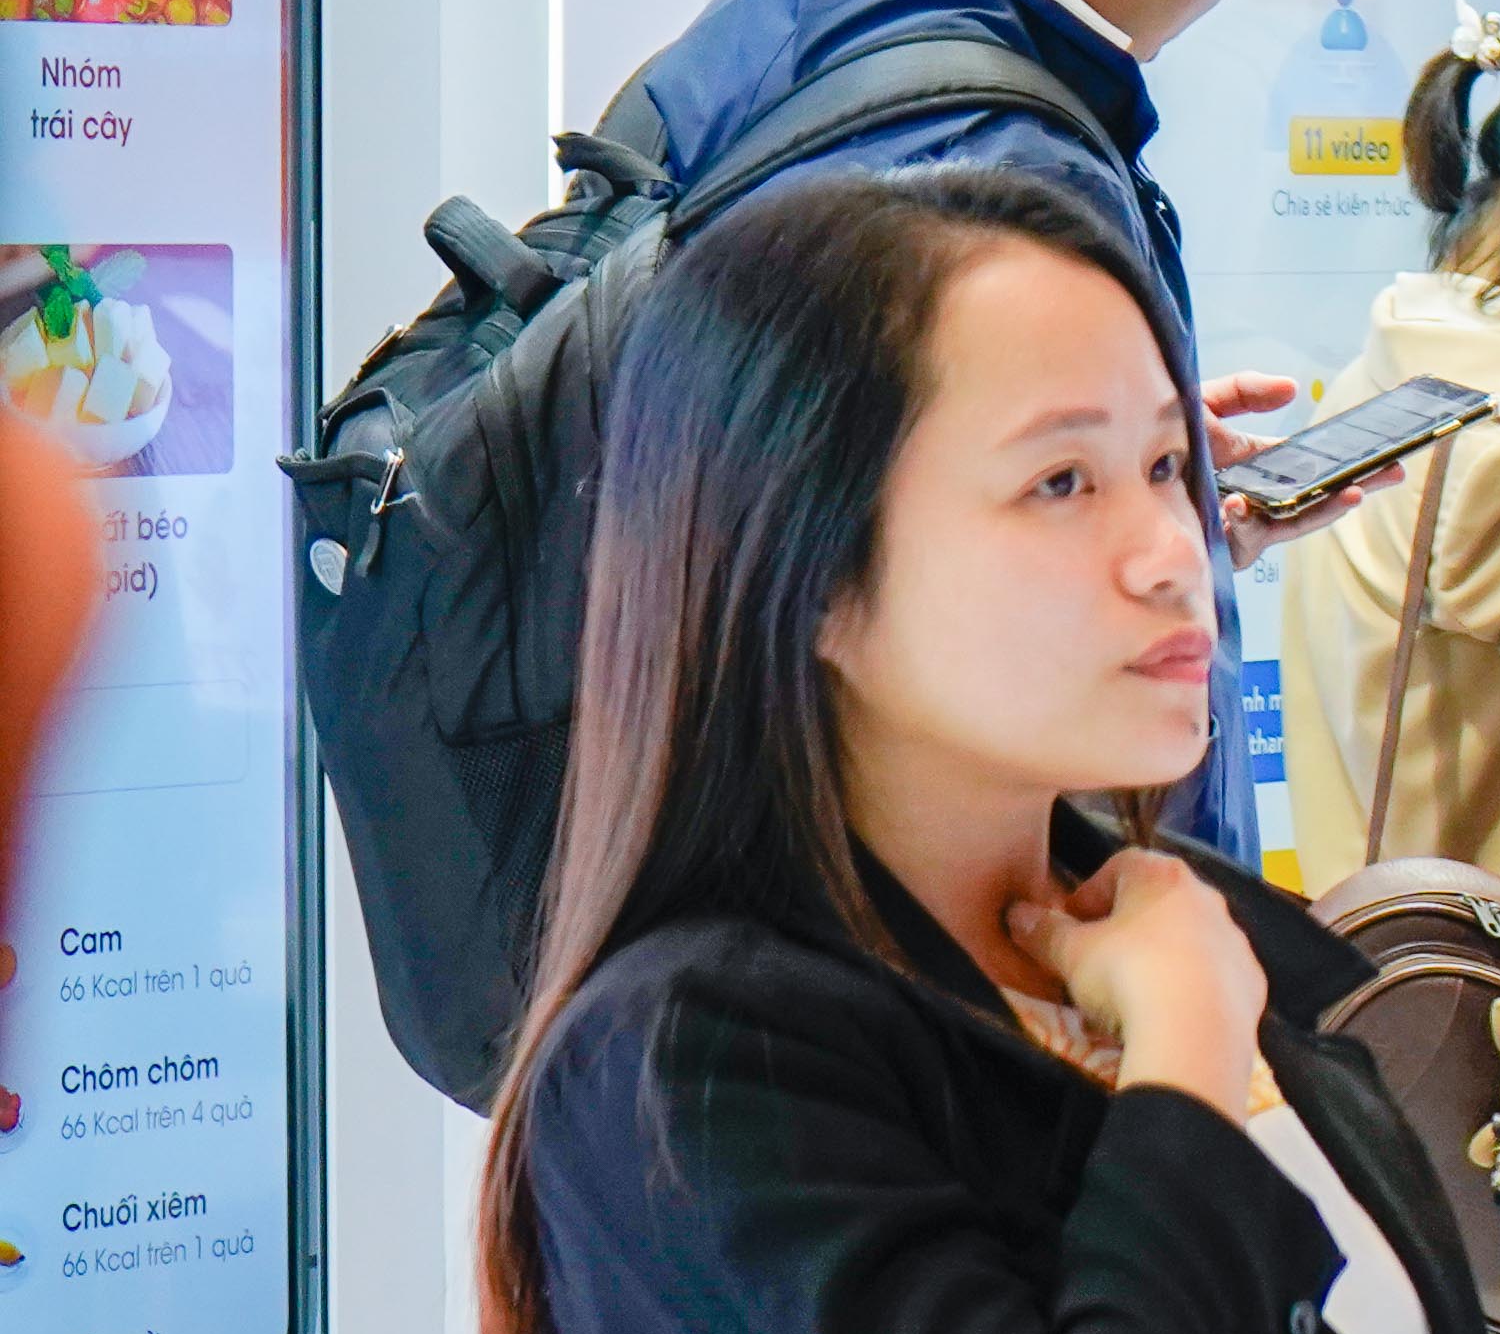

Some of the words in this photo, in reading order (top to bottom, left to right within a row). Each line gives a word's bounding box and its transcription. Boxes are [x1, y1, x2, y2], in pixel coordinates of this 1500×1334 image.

[42, 56, 121, 88] Nhóm
[31, 108, 73, 140] trái
[83, 110, 133, 147] cây
[1304, 126, 1323, 161] 11
[1331, 126, 1391, 162] video
[1272, 189, 1310, 217] Chia
[137, 509, 188, 541] béo
[106, 560, 159, 602] pid)
[1242, 684, 1266, 713] nh
[60, 927, 122, 956] Cam
[60, 976, 86, 1003] 66
[92, 970, 138, 1000] Kcal
[144, 968, 185, 994] trên
[192, 964, 200, 989] 1
[209, 959, 252, 993] quả
[61, 1062, 139, 1094] Chôm
[148, 1054, 219, 1085] chôm
[61, 1114, 86, 1140] 66
[93, 1107, 139, 1137] Kcal
[145, 1105, 186, 1131] trên
[192, 1100, 203, 1124] 4
[211, 1094, 254, 1127] quả
[62, 1193, 139, 1233] Chuối
[147, 1191, 207, 1222] xiêm
[63, 1251, 88, 1279] 66
[94, 1244, 140, 1274] Kcal
[147, 1241, 187, 1267] trên
[195, 1235, 202, 1260] 1
[212, 1228, 255, 1263] quả
